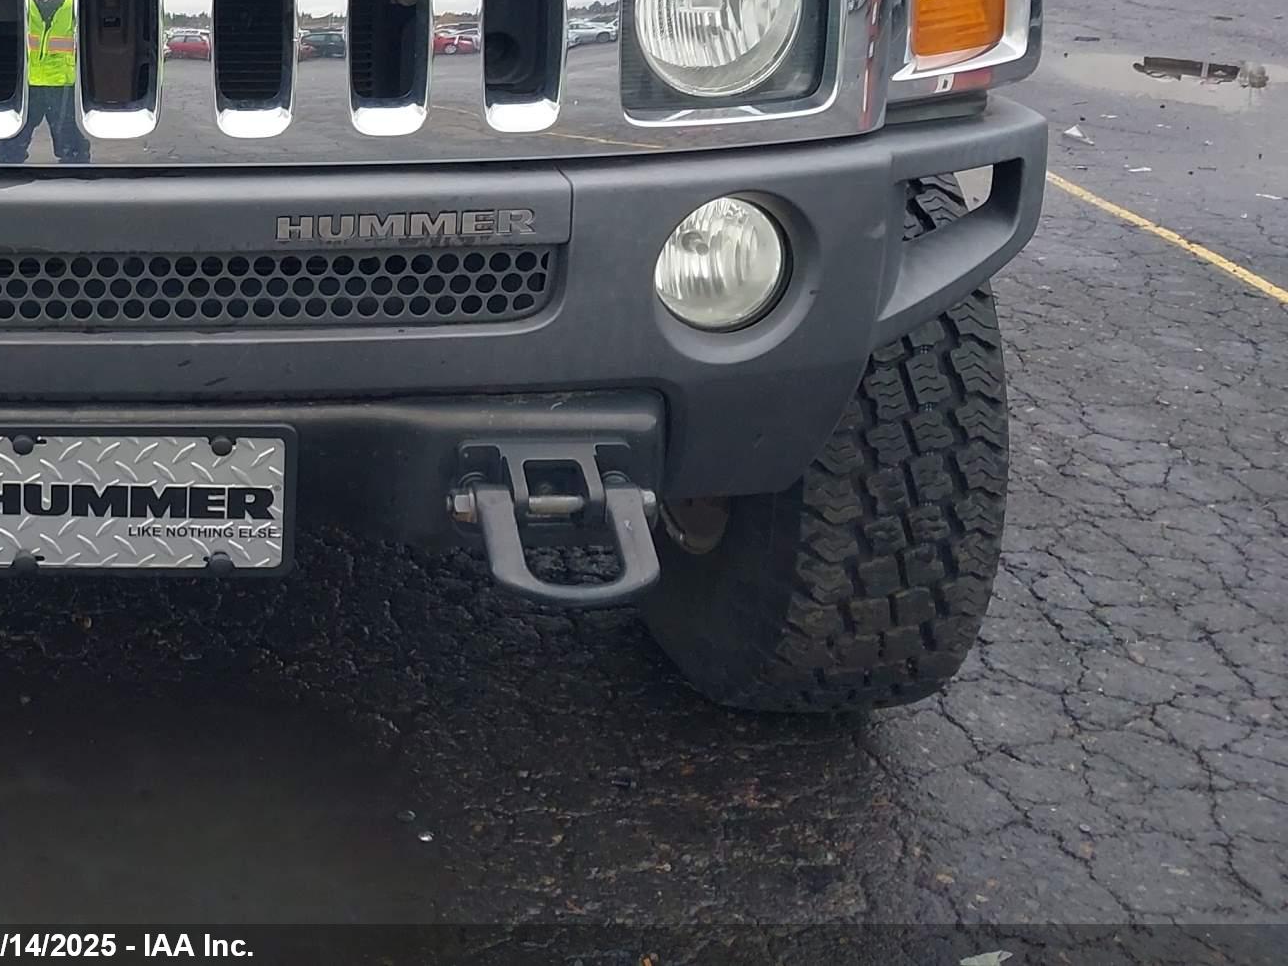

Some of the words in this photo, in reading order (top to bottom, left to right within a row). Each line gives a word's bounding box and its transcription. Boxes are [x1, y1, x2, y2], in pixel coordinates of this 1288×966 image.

[275, 208, 537, 242] HUMMER
[127, 524, 162, 538] LIKE
[166, 525, 234, 539] NOTHING
[238, 526, 278, 540] ELSE
